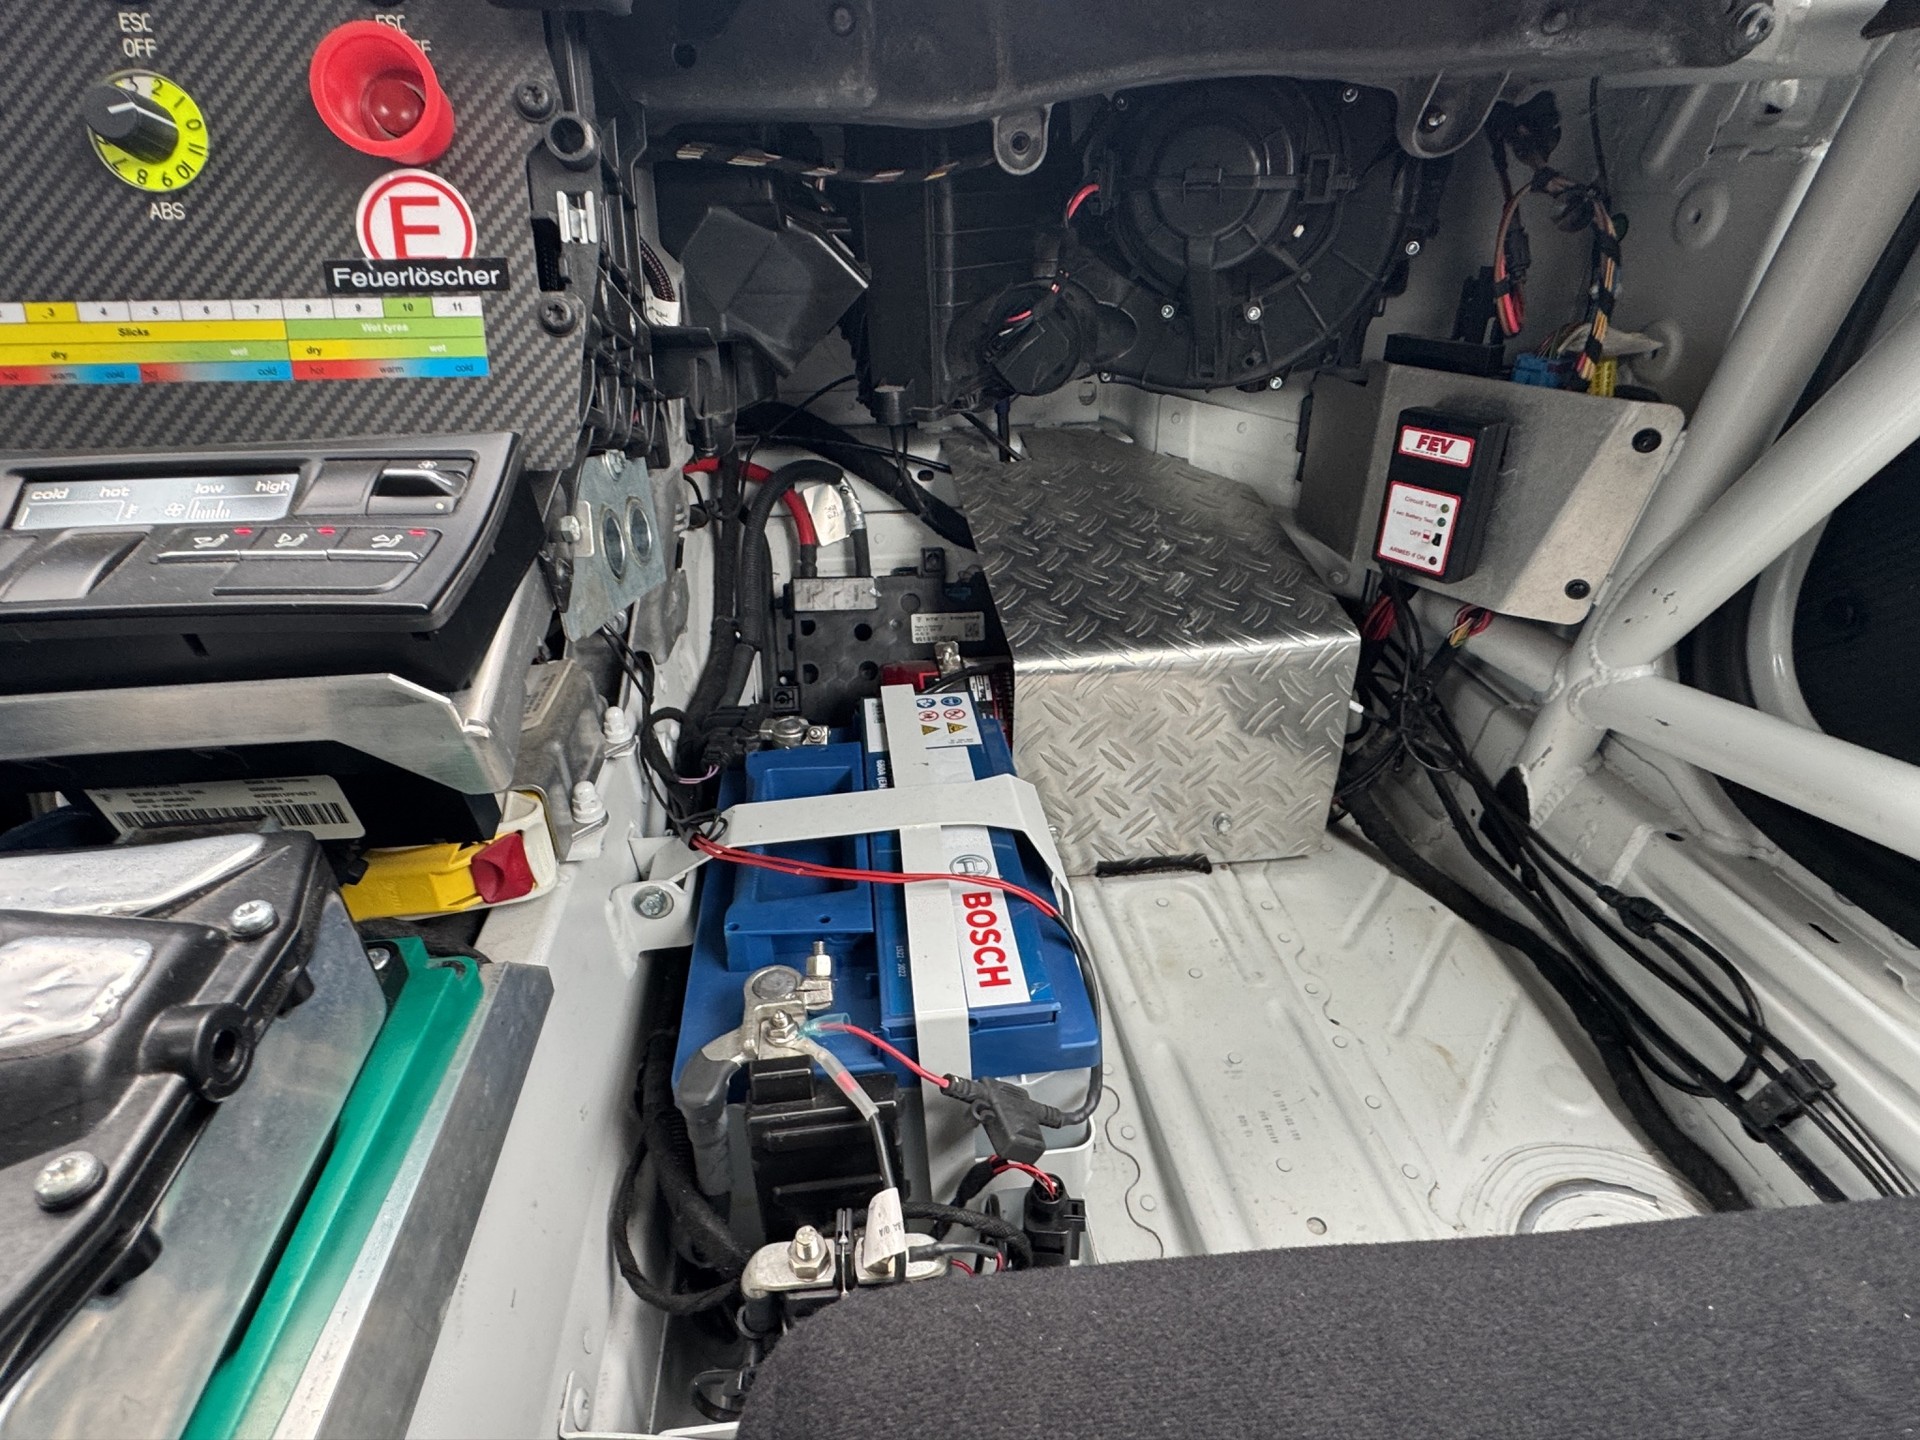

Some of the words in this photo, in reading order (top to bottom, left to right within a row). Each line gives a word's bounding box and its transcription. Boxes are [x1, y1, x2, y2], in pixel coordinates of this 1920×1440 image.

[118, 12, 153, 33] ESC
[122, 37, 158, 58] OFF
[152, 79, 163, 97] 2
[173, 95, 186, 110] 1
[186, 118, 202, 131] 0
[136, 168, 148, 185] 8
[150, 201, 186, 221] ABS
[332, 265, 501, 288] Feuerlöscher
[118, 327, 150, 337] Slicks
[361, 323, 383, 333] Wet
[384, 323, 409, 334] tyres
[306, 346, 322, 356] dry
[429, 343, 447, 353] wet
[51, 350, 68, 360] dry
[380, 365, 404, 374] warm
[456, 363, 474, 372] cold
[1416, 434, 1455, 454] FEV
[100, 486, 130, 498] hot
[195, 483, 224, 494] low
[255, 480, 290, 494] high
[31, 488, 69, 500] cold
[1404, 495, 1424, 506] Circuit
[1425, 501, 1437, 509] Test
[1405, 512, 1422, 522] Battery
[1409, 529, 1421, 537] OFF
[1389, 546, 1411, 557] ARMED
[962, 891, 1012, 988] BOSCH
